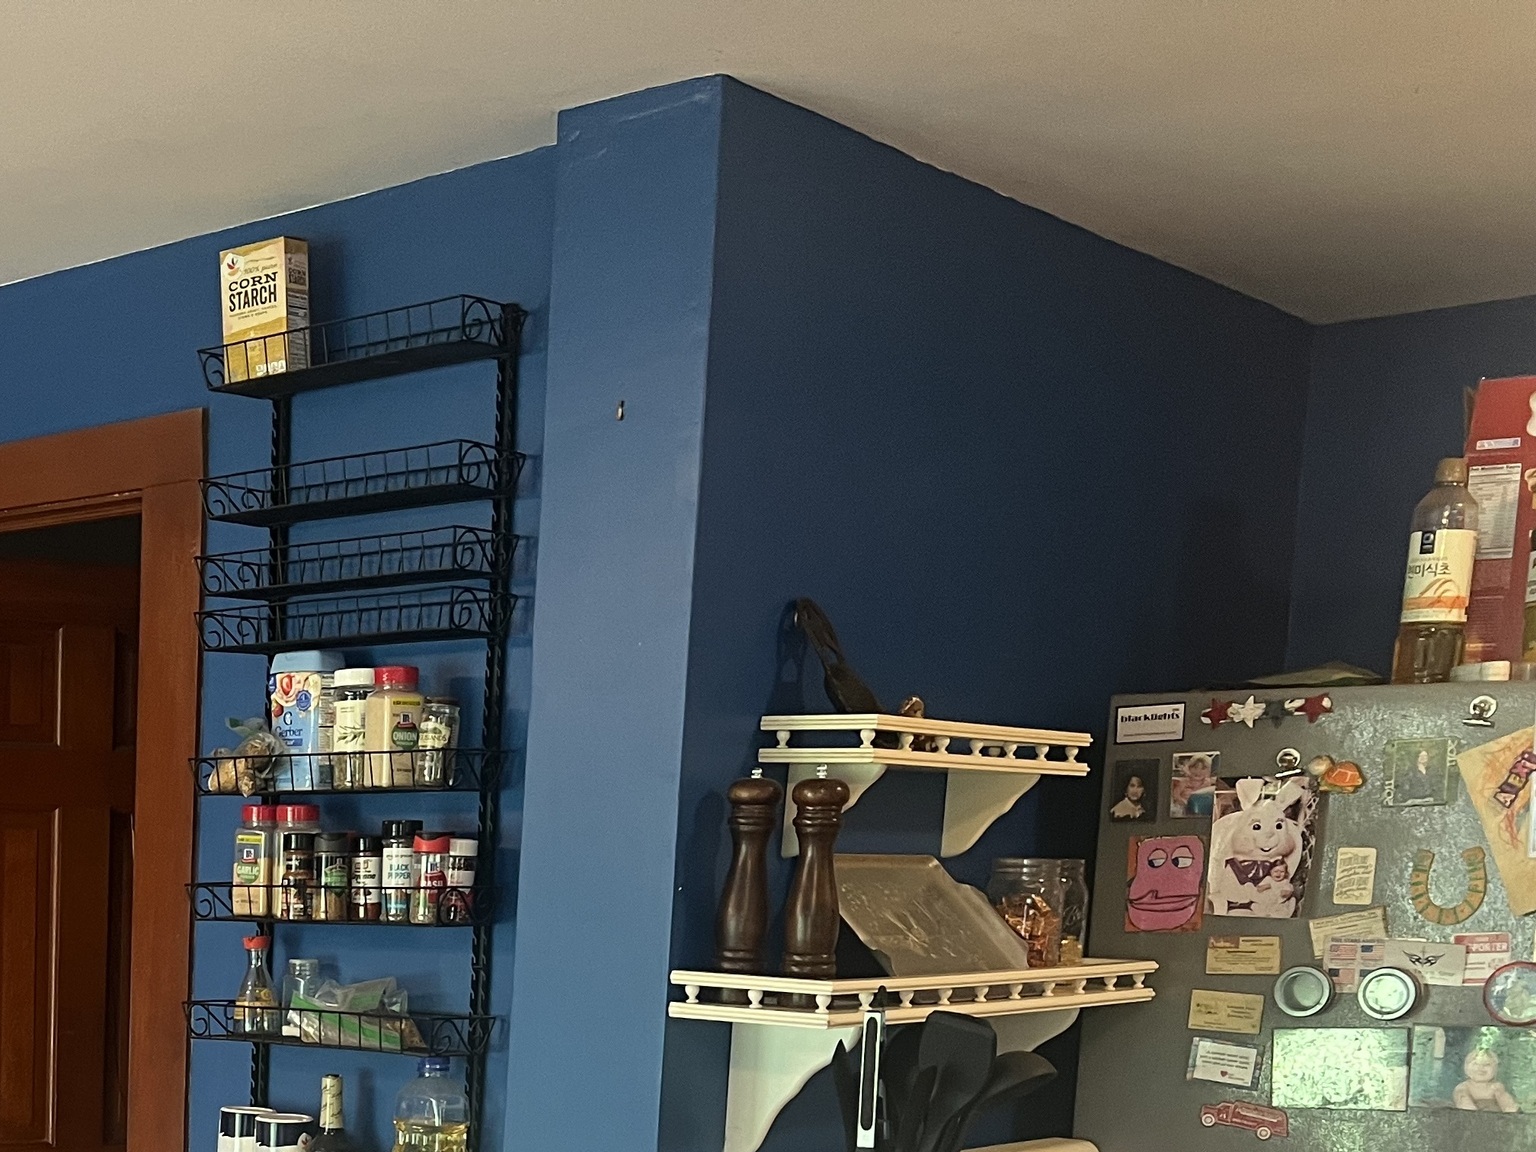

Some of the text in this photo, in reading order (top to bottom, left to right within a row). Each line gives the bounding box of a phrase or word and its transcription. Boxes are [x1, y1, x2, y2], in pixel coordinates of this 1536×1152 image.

[228, 271, 278, 292] CORN
[229, 283, 277, 313] STARCH
[275, 725, 303, 737] Gerber
[392, 731, 418, 741] ONION
